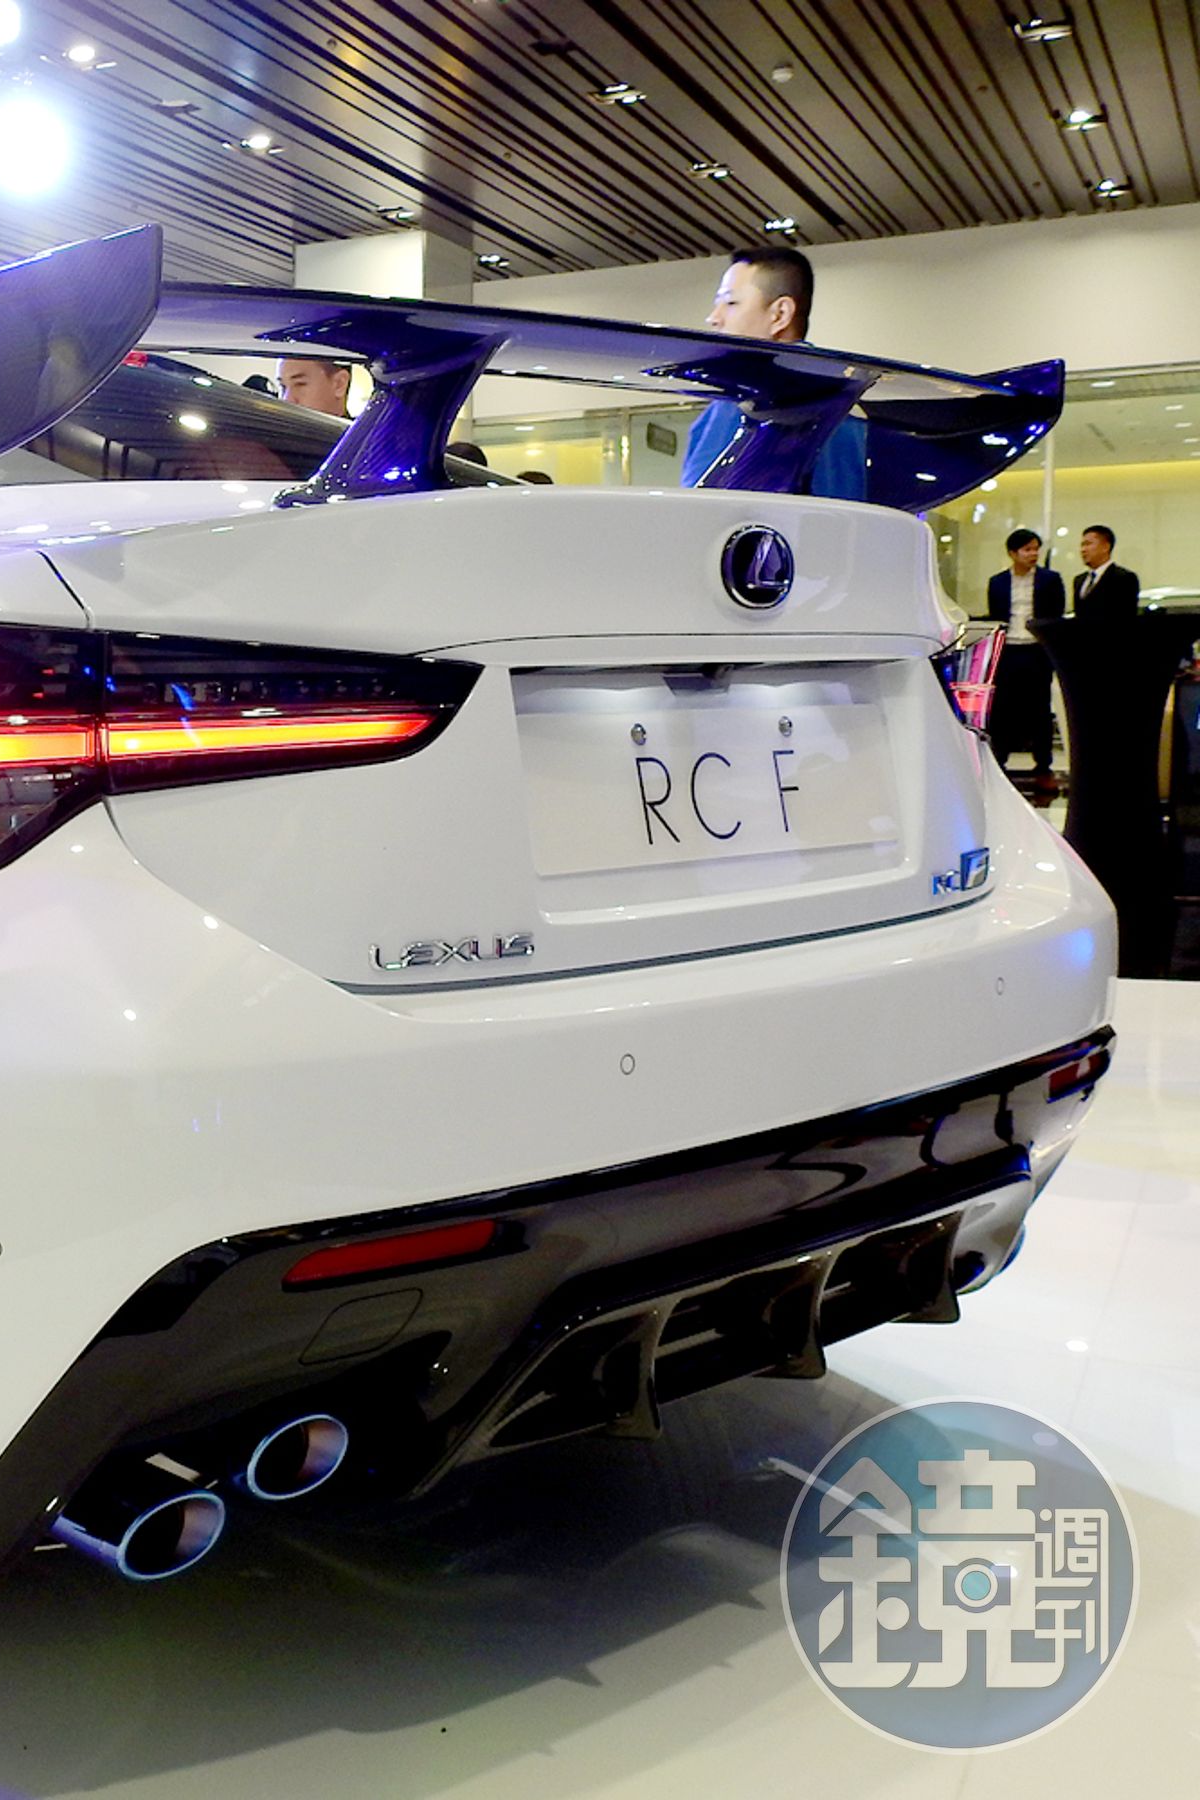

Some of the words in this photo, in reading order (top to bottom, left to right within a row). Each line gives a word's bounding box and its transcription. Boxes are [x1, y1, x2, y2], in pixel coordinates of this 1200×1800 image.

[635, 752, 742, 845] RC
[772, 749, 799, 832] F
[367, 931, 536, 971] LEXUS
